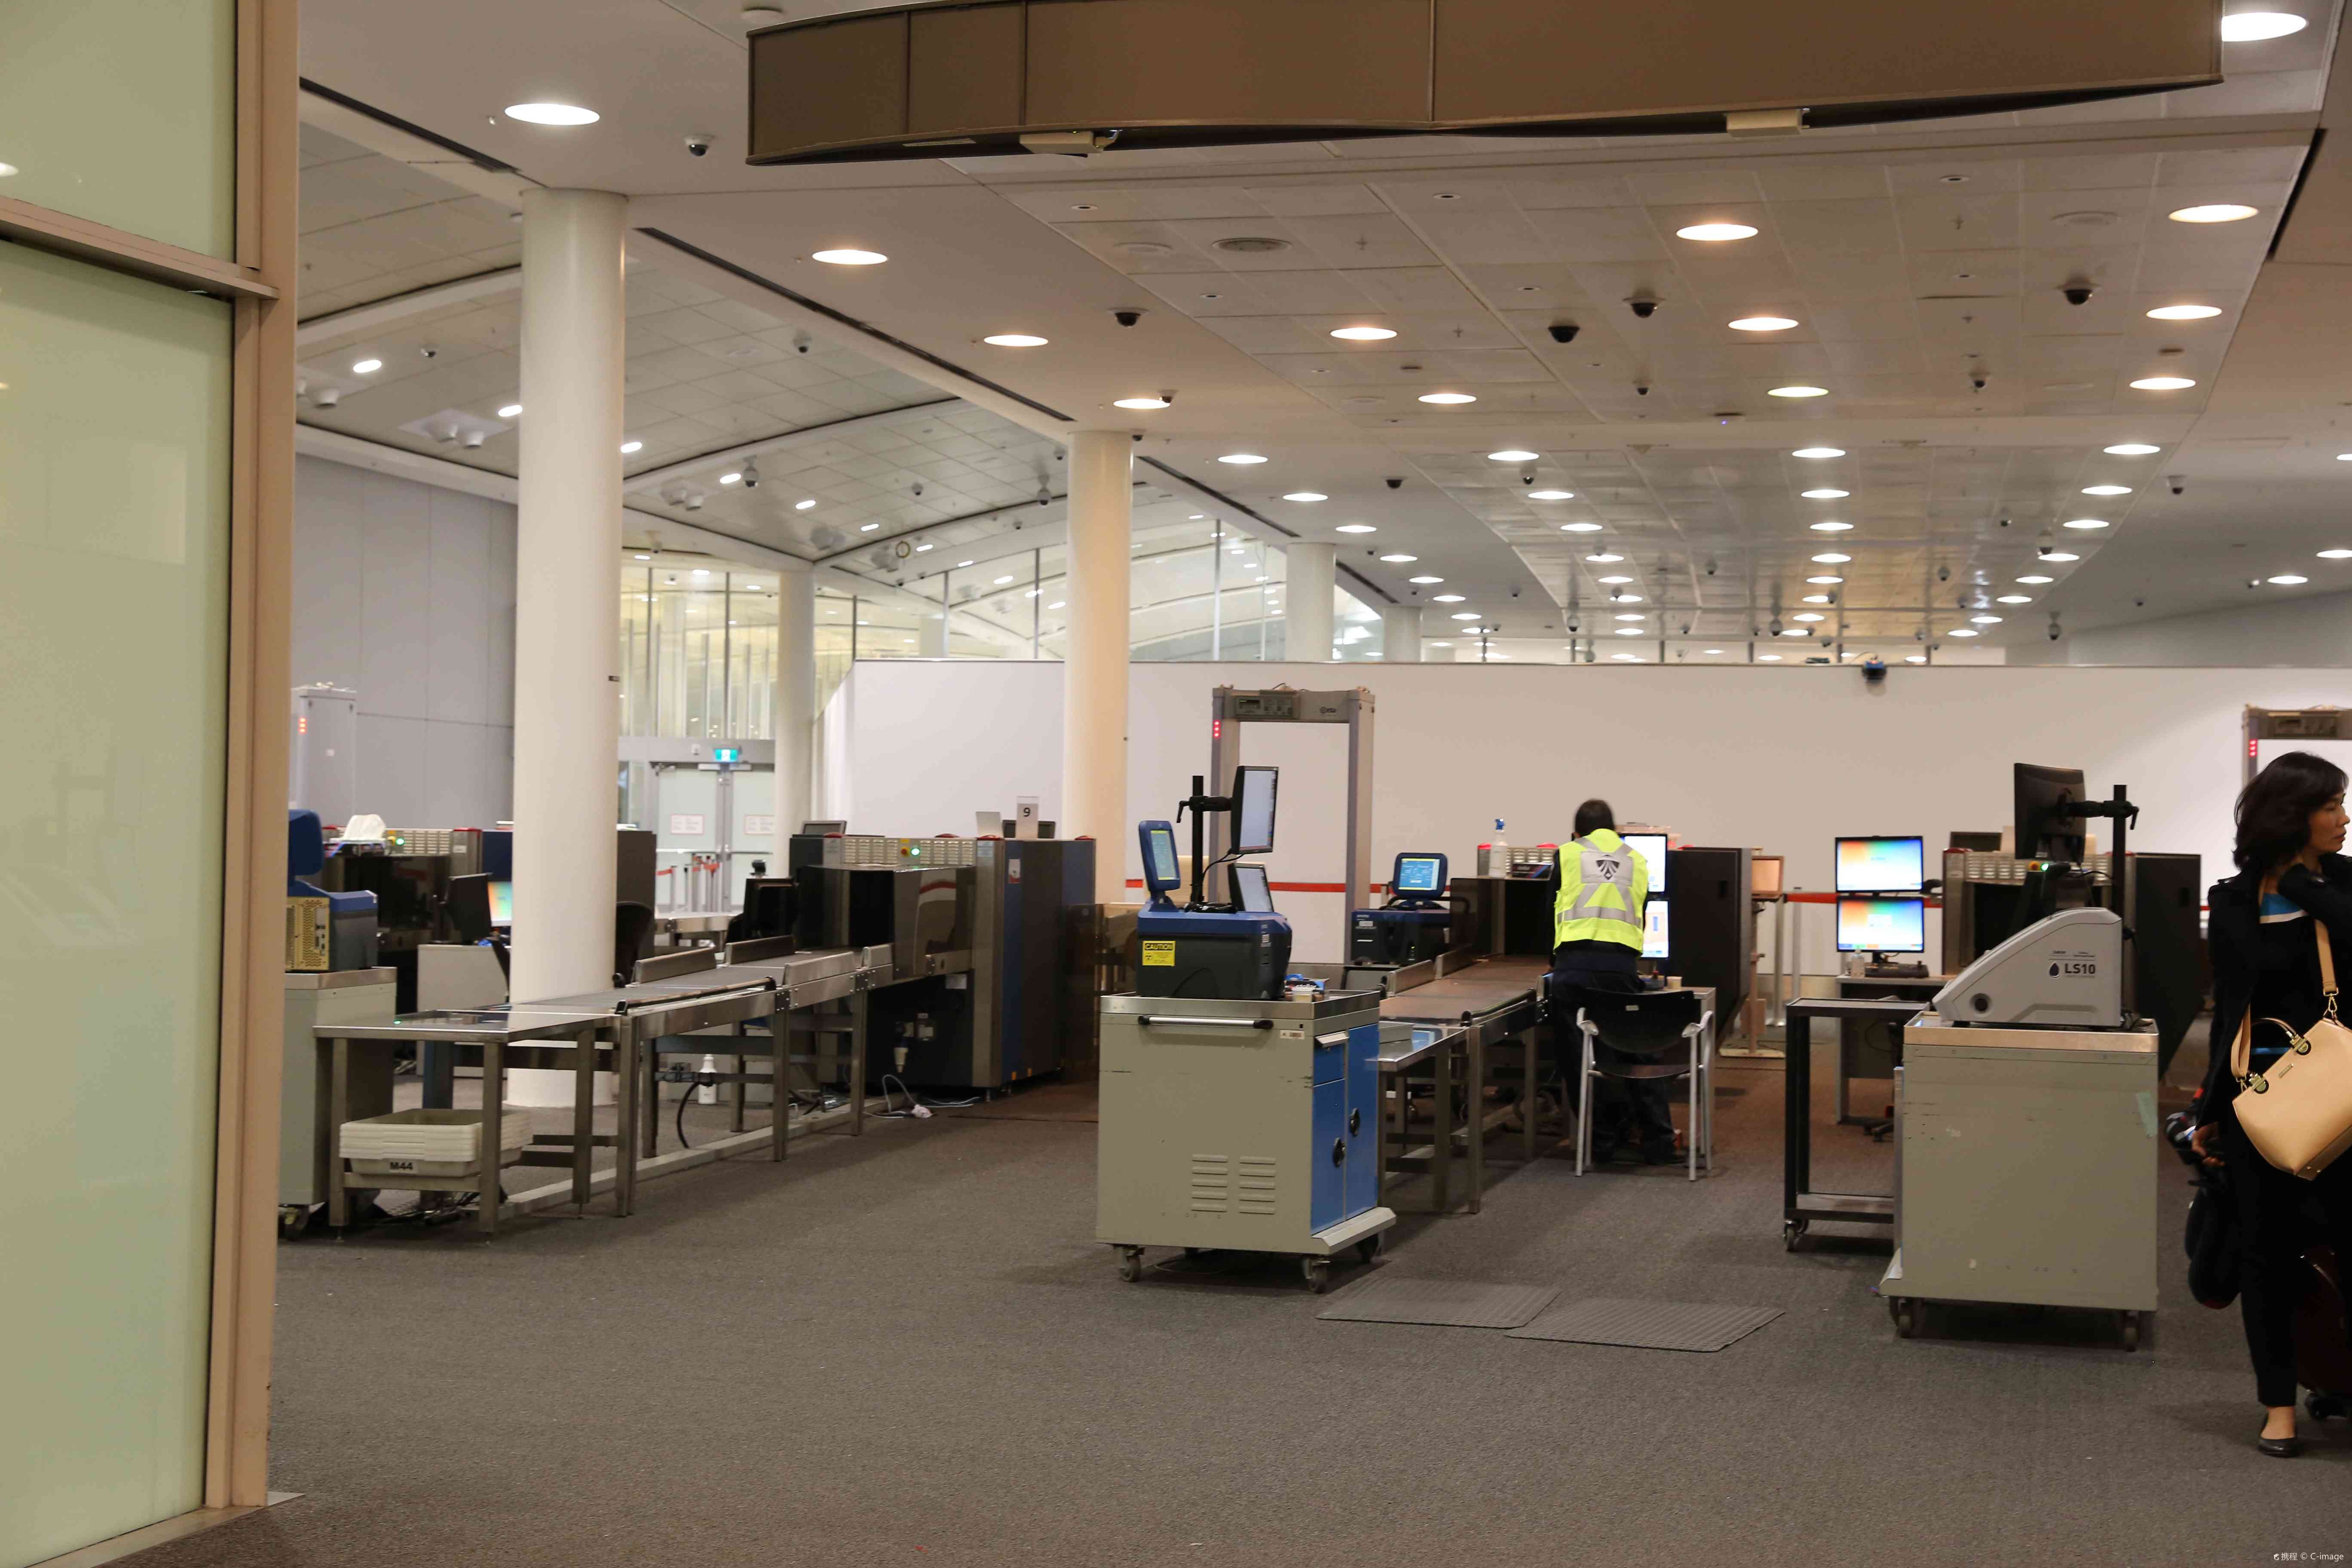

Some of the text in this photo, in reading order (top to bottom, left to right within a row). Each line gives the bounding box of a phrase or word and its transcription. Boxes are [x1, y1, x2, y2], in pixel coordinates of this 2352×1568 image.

[1023, 807, 1030, 817] 9
[2064, 963, 2096, 974] LS10
[390, 1162, 413, 1170] M44
